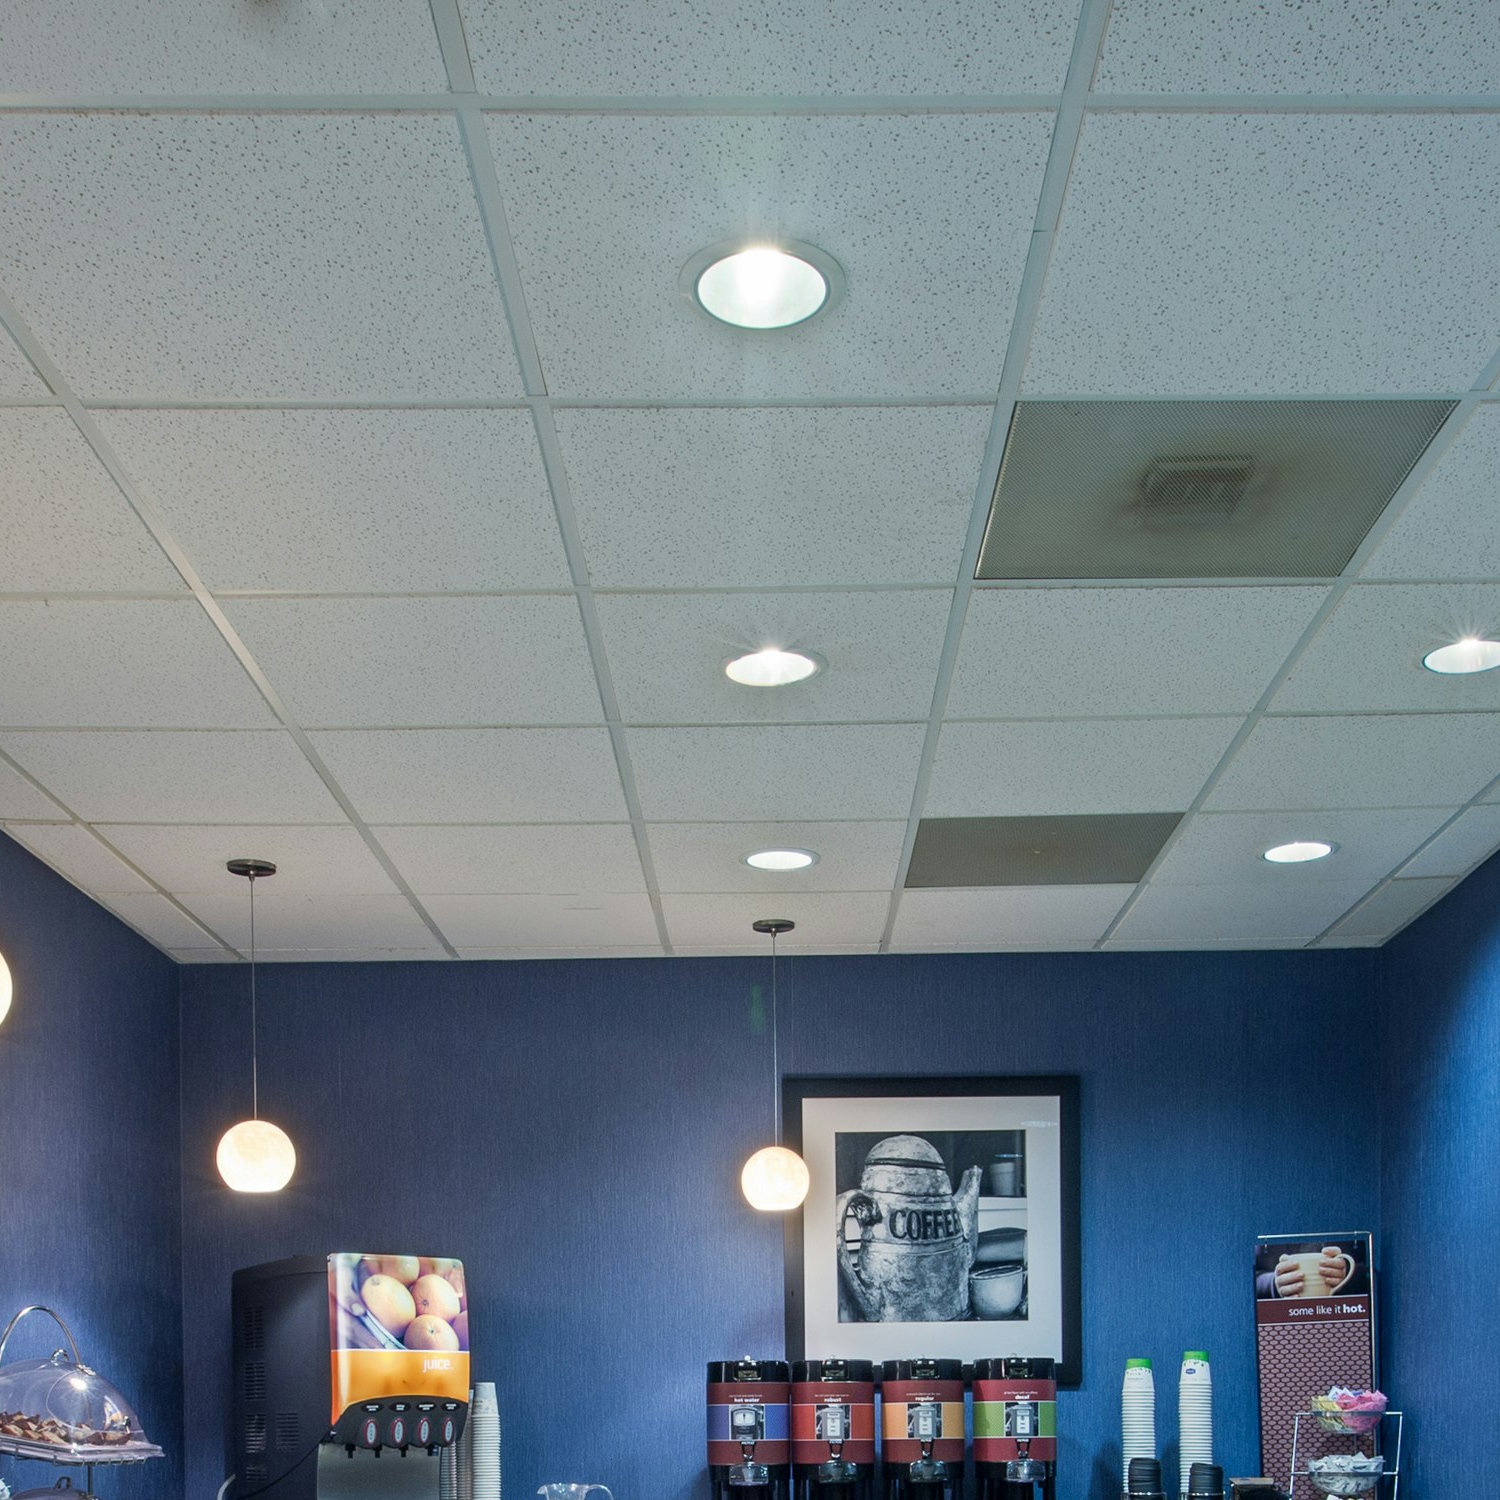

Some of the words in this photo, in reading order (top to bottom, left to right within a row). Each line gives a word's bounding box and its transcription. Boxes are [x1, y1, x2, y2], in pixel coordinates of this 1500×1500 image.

[889, 1209, 963, 1240] COFFEE
[1288, 1308, 1314, 1316] some
[1316, 1305, 1333, 1314] like
[1334, 1304, 1342, 1314] it
[1342, 1304, 1366, 1314] hot.
